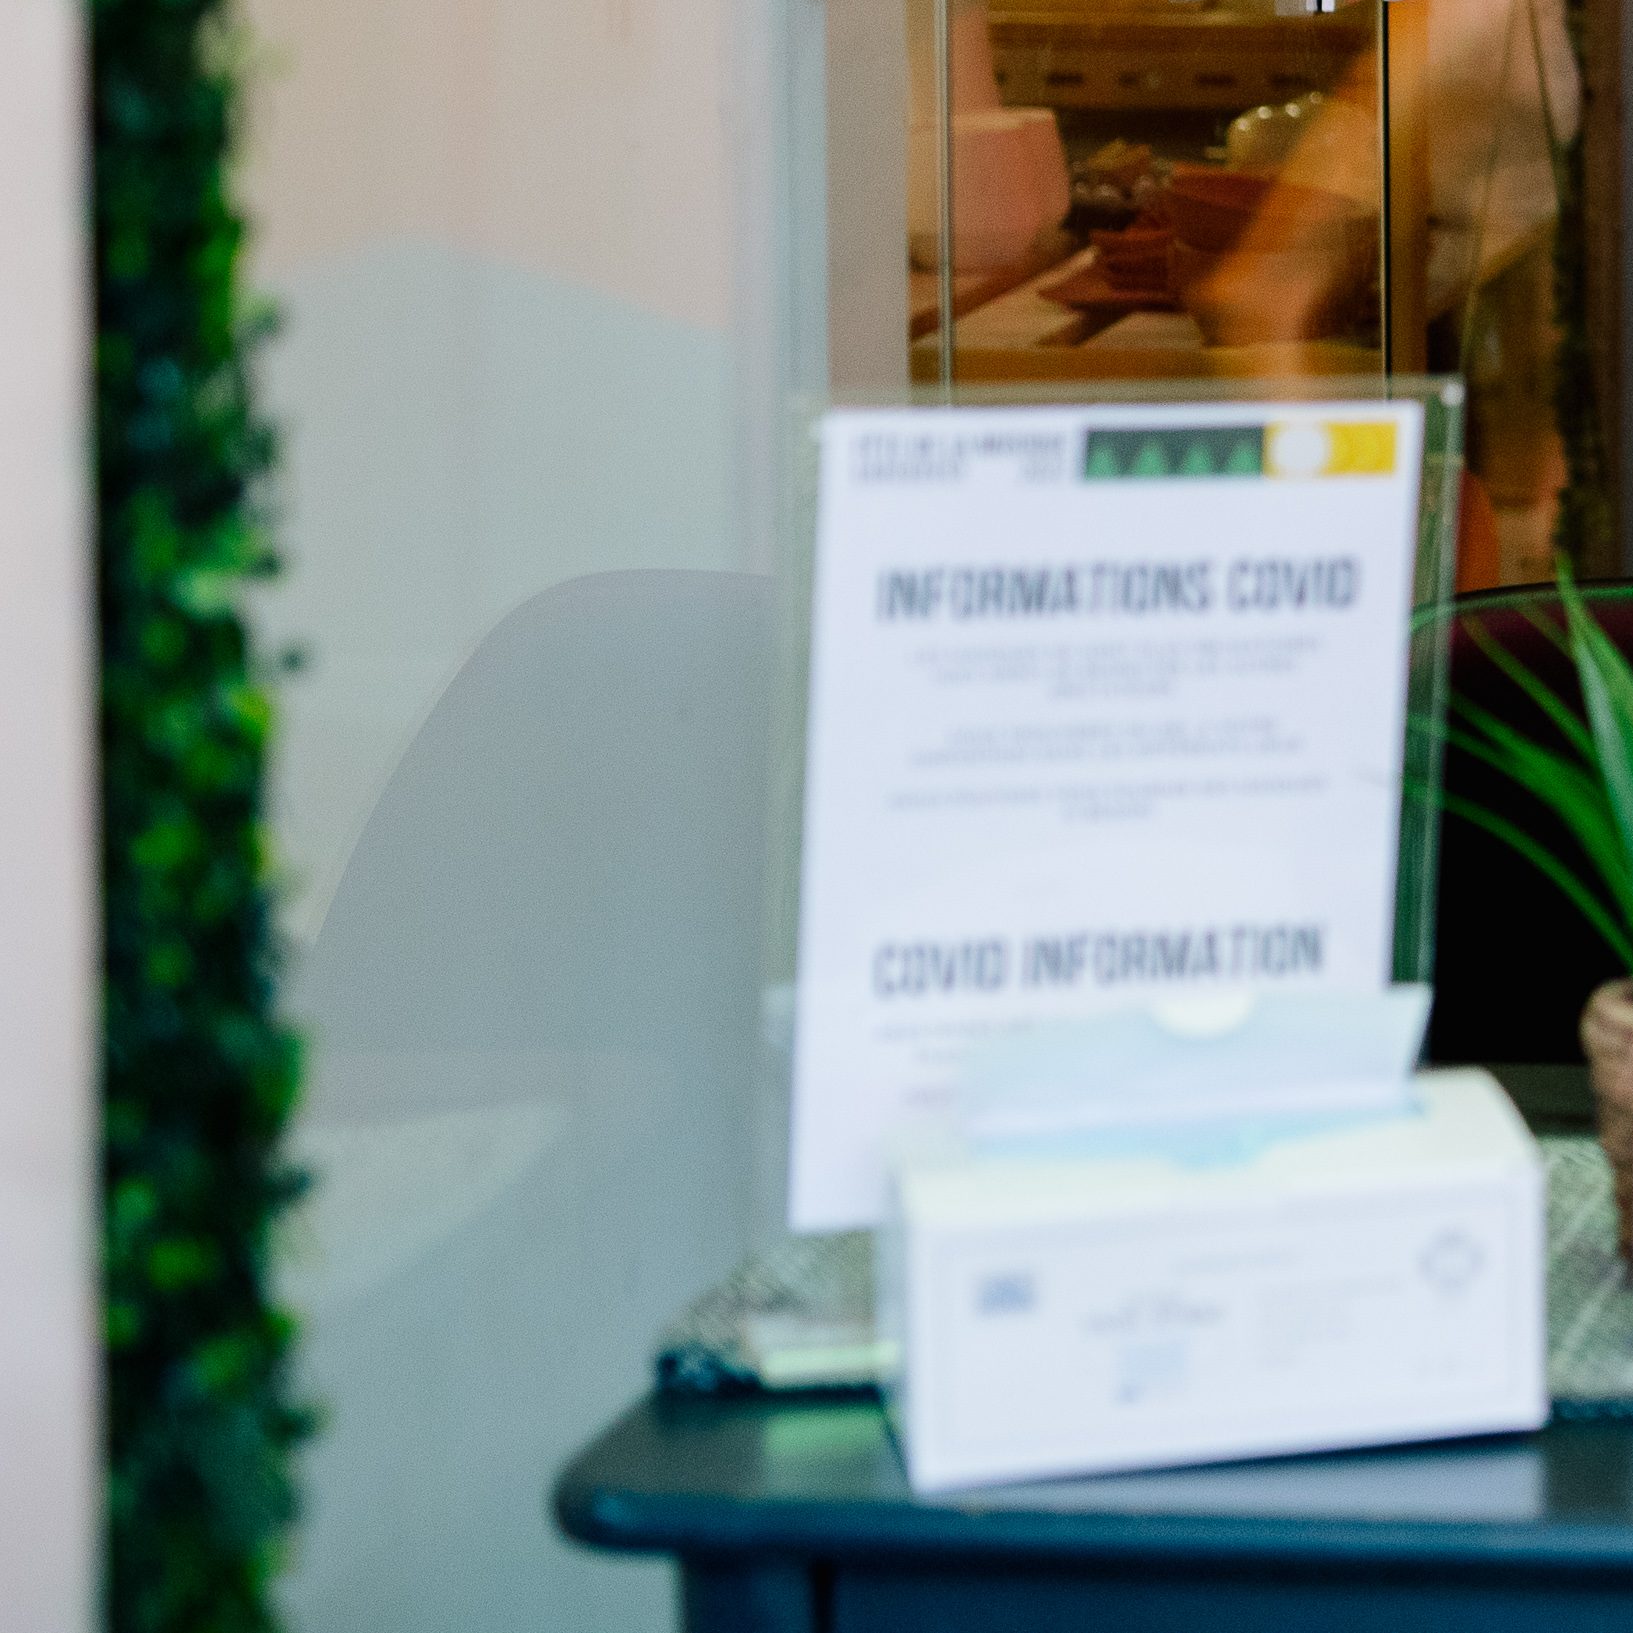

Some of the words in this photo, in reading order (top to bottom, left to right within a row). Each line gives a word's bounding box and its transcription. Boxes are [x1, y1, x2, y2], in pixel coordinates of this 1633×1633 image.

[877, 557, 1214, 624] INFORMATIONS
[1226, 554, 1360, 613] COVID
[873, 936, 1010, 999] COVID
[1020, 923, 1325, 991] INFORMATION
